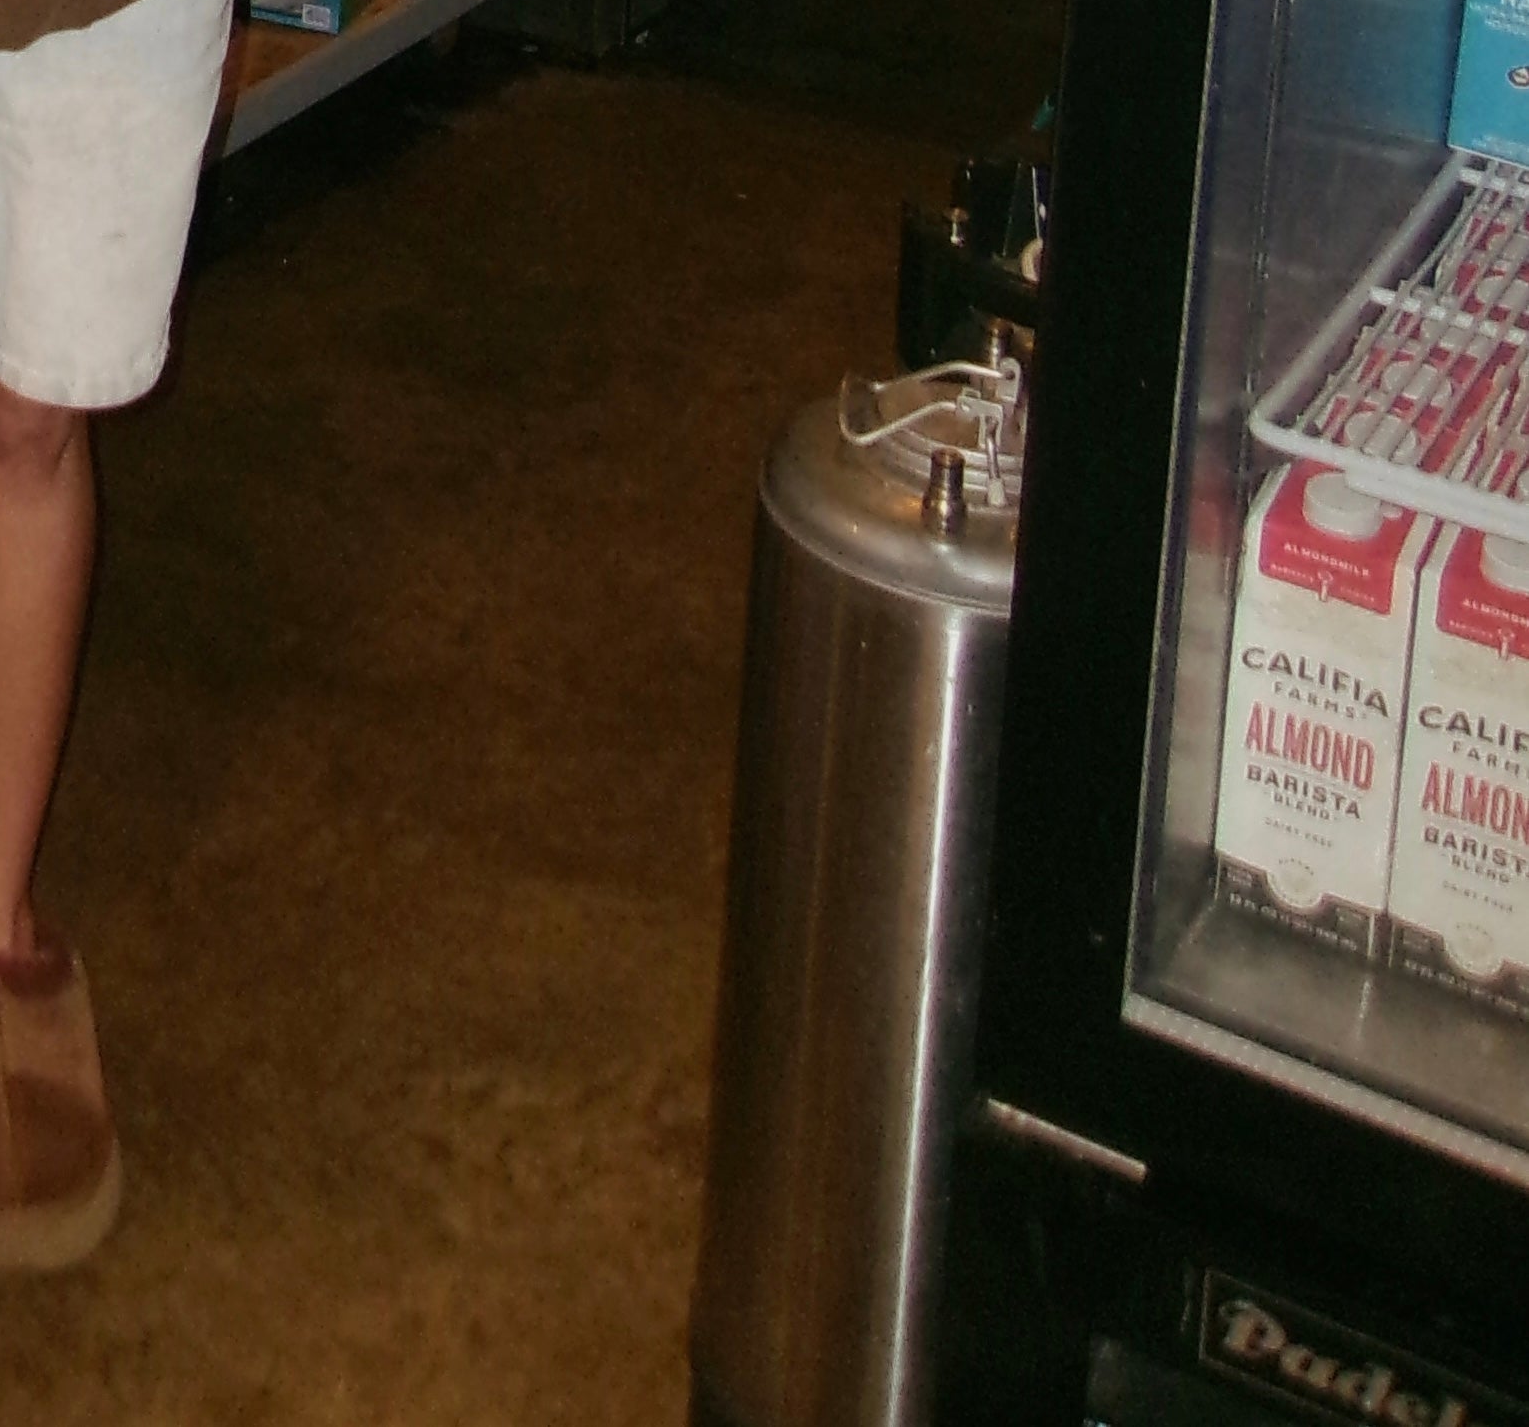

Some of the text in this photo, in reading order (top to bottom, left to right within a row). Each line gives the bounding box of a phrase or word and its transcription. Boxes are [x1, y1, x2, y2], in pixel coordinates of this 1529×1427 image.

[1283, 541, 1371, 578] ALMONDMILK
[1241, 646, 1389, 718] CALIFIA
[1274, 680, 1355, 720] FARMS
[1245, 700, 1375, 791] ALMOND
[1452, 740, 1529, 780] FARM
[1246, 763, 1362, 820] BARISTA
[1424, 825, 1529, 880] BARIST
